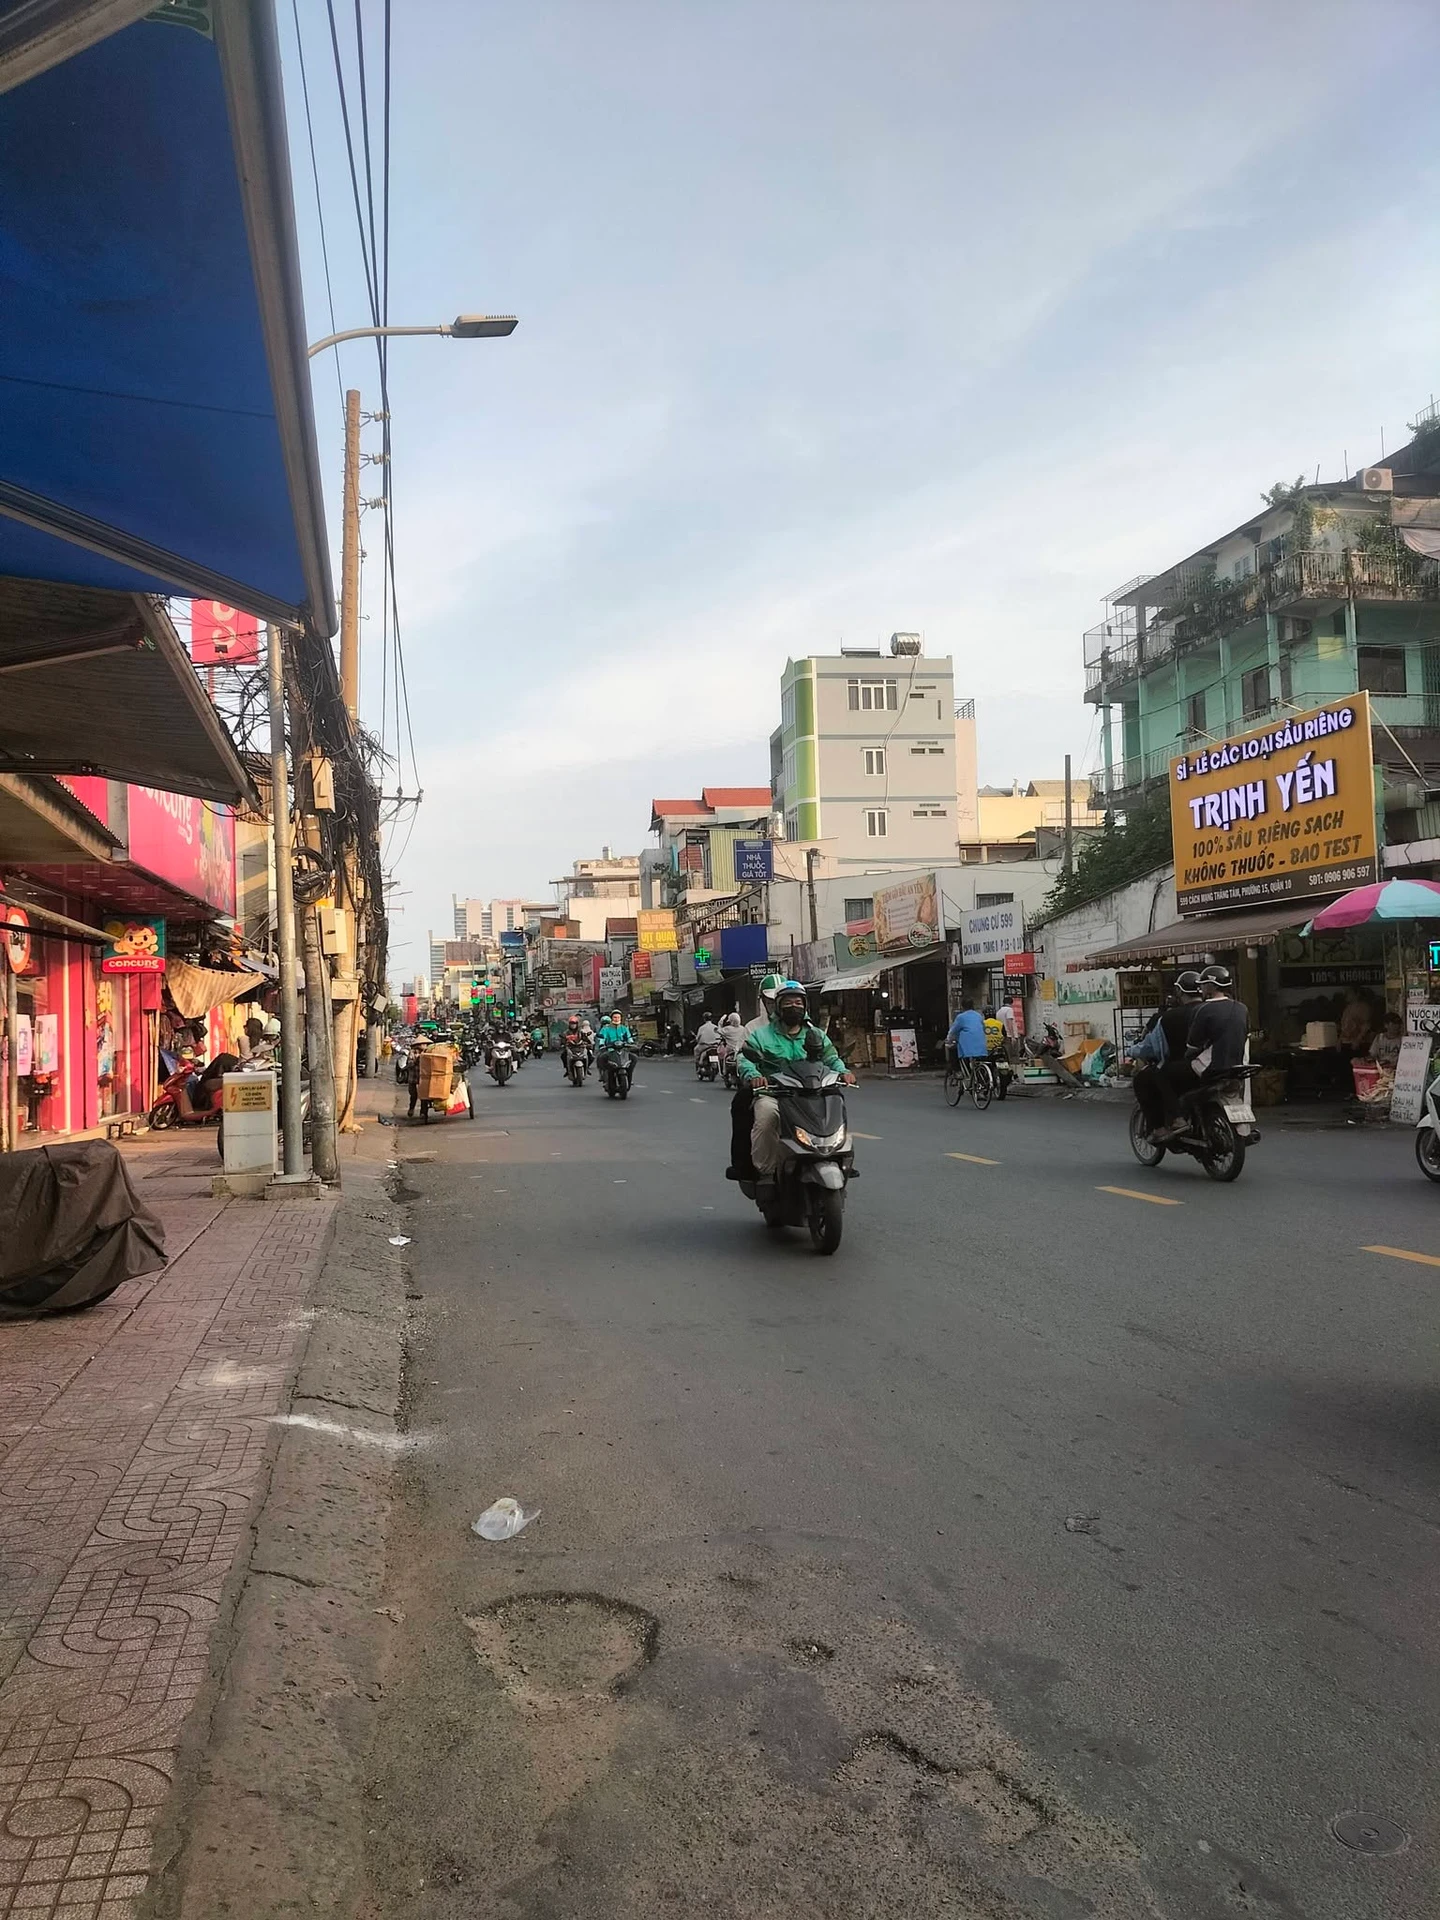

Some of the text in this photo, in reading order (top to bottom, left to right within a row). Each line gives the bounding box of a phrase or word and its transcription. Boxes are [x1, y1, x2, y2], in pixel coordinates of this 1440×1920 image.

[1210, 743, 1240, 770] CÁC
[1242, 735, 1274, 761] LOẠI
[1275, 719, 1304, 750] SẦU
[1304, 707, 1353, 741] RIÊNG
[1190, 751, 1336, 832] TRỊNH YẾN
[1192, 810, 1345, 859] 100% SẦU RIÊNG SẠCH
[742, 860, 766, 870] THUỐC
[1184, 858, 1226, 885] KHÔNG
[1231, 847, 1275, 876] THUỐC
[1290, 841, 1320, 866] BAO
[1324, 834, 1362, 859] TEST
[969, 916, 989, 934] CHUNG
[1000, 912, 1014, 929] 599
[655, 930, 677, 943] QUAY
[108, 958, 160, 969] concung
[1141, 994, 1160, 1006] TEST
